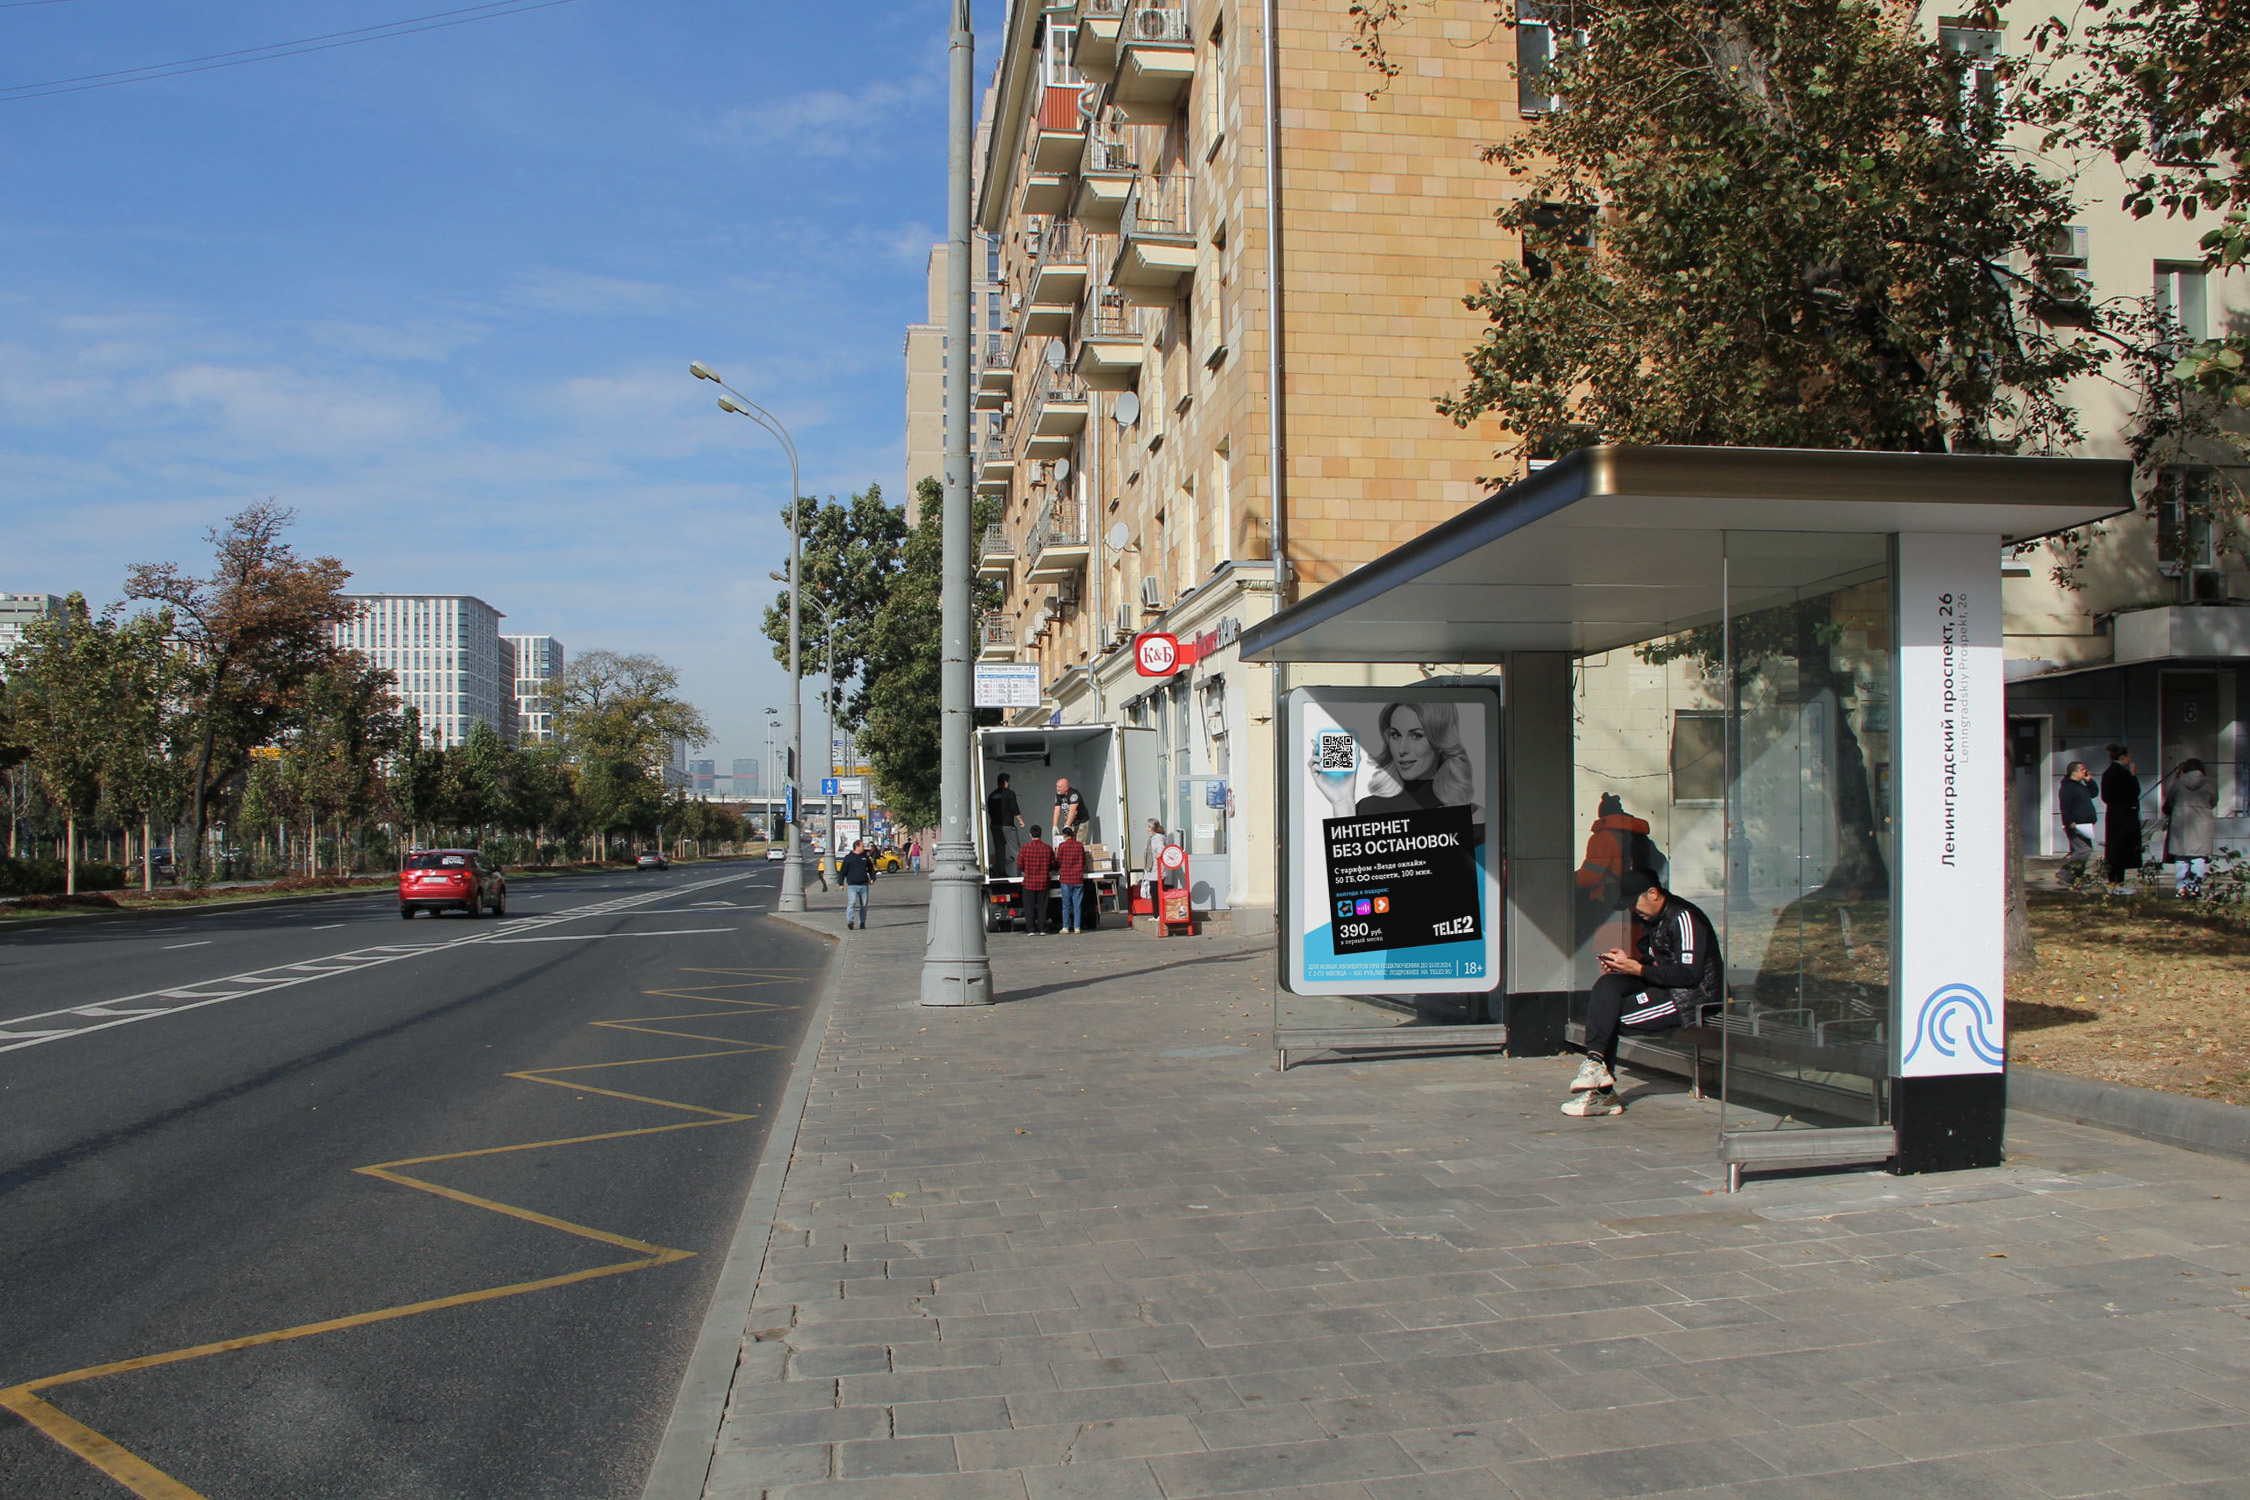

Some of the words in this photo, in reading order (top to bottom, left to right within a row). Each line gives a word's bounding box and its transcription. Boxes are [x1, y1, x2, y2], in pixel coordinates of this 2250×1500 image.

[1939, 592, 1954, 616] 26
[1957, 593, 1968, 609] 26
[1958, 611, 1969, 670] Prospekt,
[1143, 647, 1173, 663] К&Б
[1942, 622, 1958, 713] проспект,
[1958, 675, 1971, 763] Leningradskiy
[2185, 704, 2196, 721] 6
[1940, 720, 1957, 867] Ленинградский
[1330, 818, 1410, 840] ИНТЕРНЕТ
[1332, 842, 1362, 858] БЕЗ
[1365, 832, 1460, 855] ОСТАНОВОК
[1341, 865, 1372, 874] тарифом
[1340, 923, 1369, 938] 390
[1371, 928, 1383, 936] руб.
[1432, 915, 1474, 937] TELE2
[1464, 962, 1483, 975] 18+
